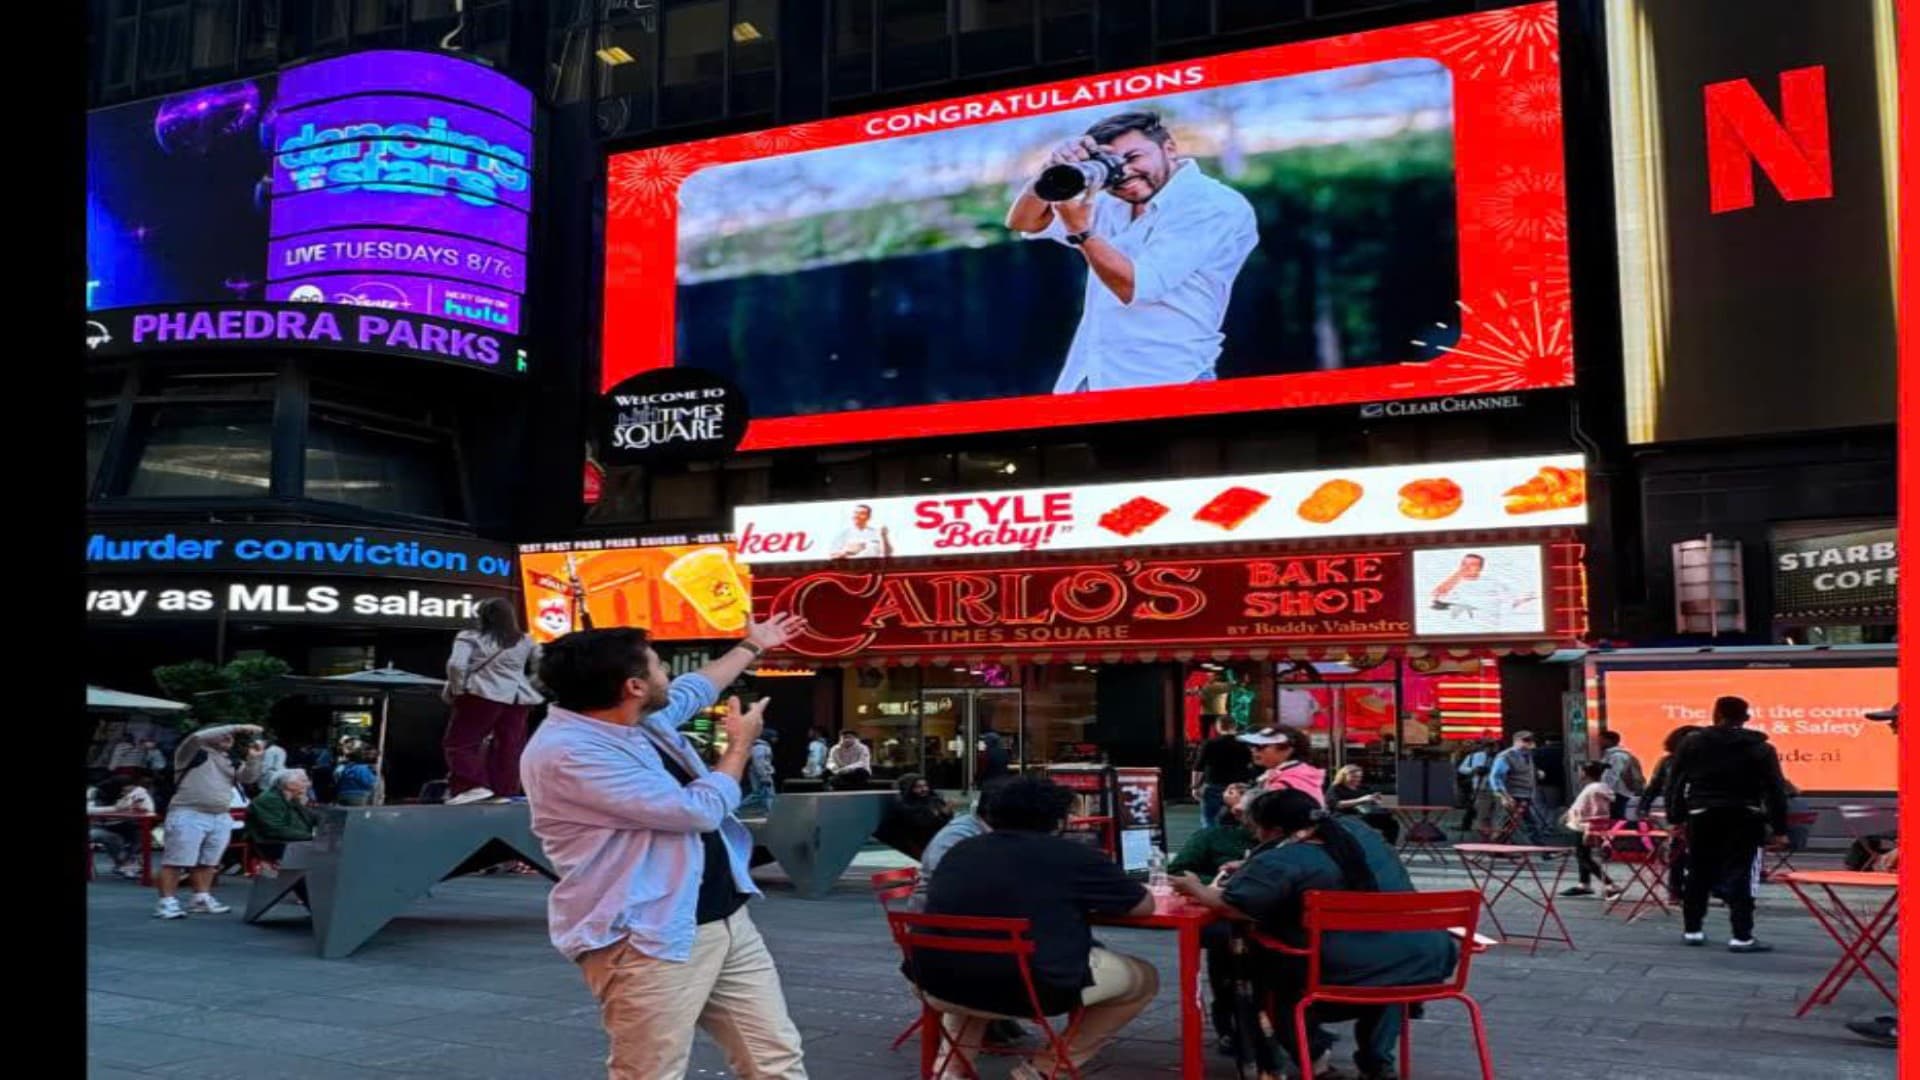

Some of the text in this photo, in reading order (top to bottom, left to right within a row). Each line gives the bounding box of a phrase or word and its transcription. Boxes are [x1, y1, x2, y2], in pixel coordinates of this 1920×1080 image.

[865, 66, 1206, 136] CONGRATULATIONS
[1703, 65, 1833, 215] N
[327, 160, 497, 207] stars
[285, 241, 514, 279] LIVE TUESDAYS 8/7c
[444, 299, 509, 325] hulu
[132, 311, 342, 344] PHAEDRA
[358, 314, 500, 365] PARKS
[614, 387, 726, 406] WELCOME TO
[658, 403, 725, 423] TIMES
[611, 415, 724, 450] SQUARE
[914, 492, 1074, 530] STYLE
[234, 535, 467, 572] conviction
[738, 522, 814, 554] ken
[1245, 554, 1386, 588] BAKE
[1778, 541, 1897, 571] STARB
[158, 589, 214, 611] as
[228, 584, 340, 613] MLS
[1242, 587, 1385, 618] SHOP
[924, 624, 1131, 644] TIMES SQUARE
[1661, 704, 1705, 719] The
[1768, 703, 1801, 719] the
[1771, 720, 1792, 736] &
[1795, 719, 1865, 738] Safety
